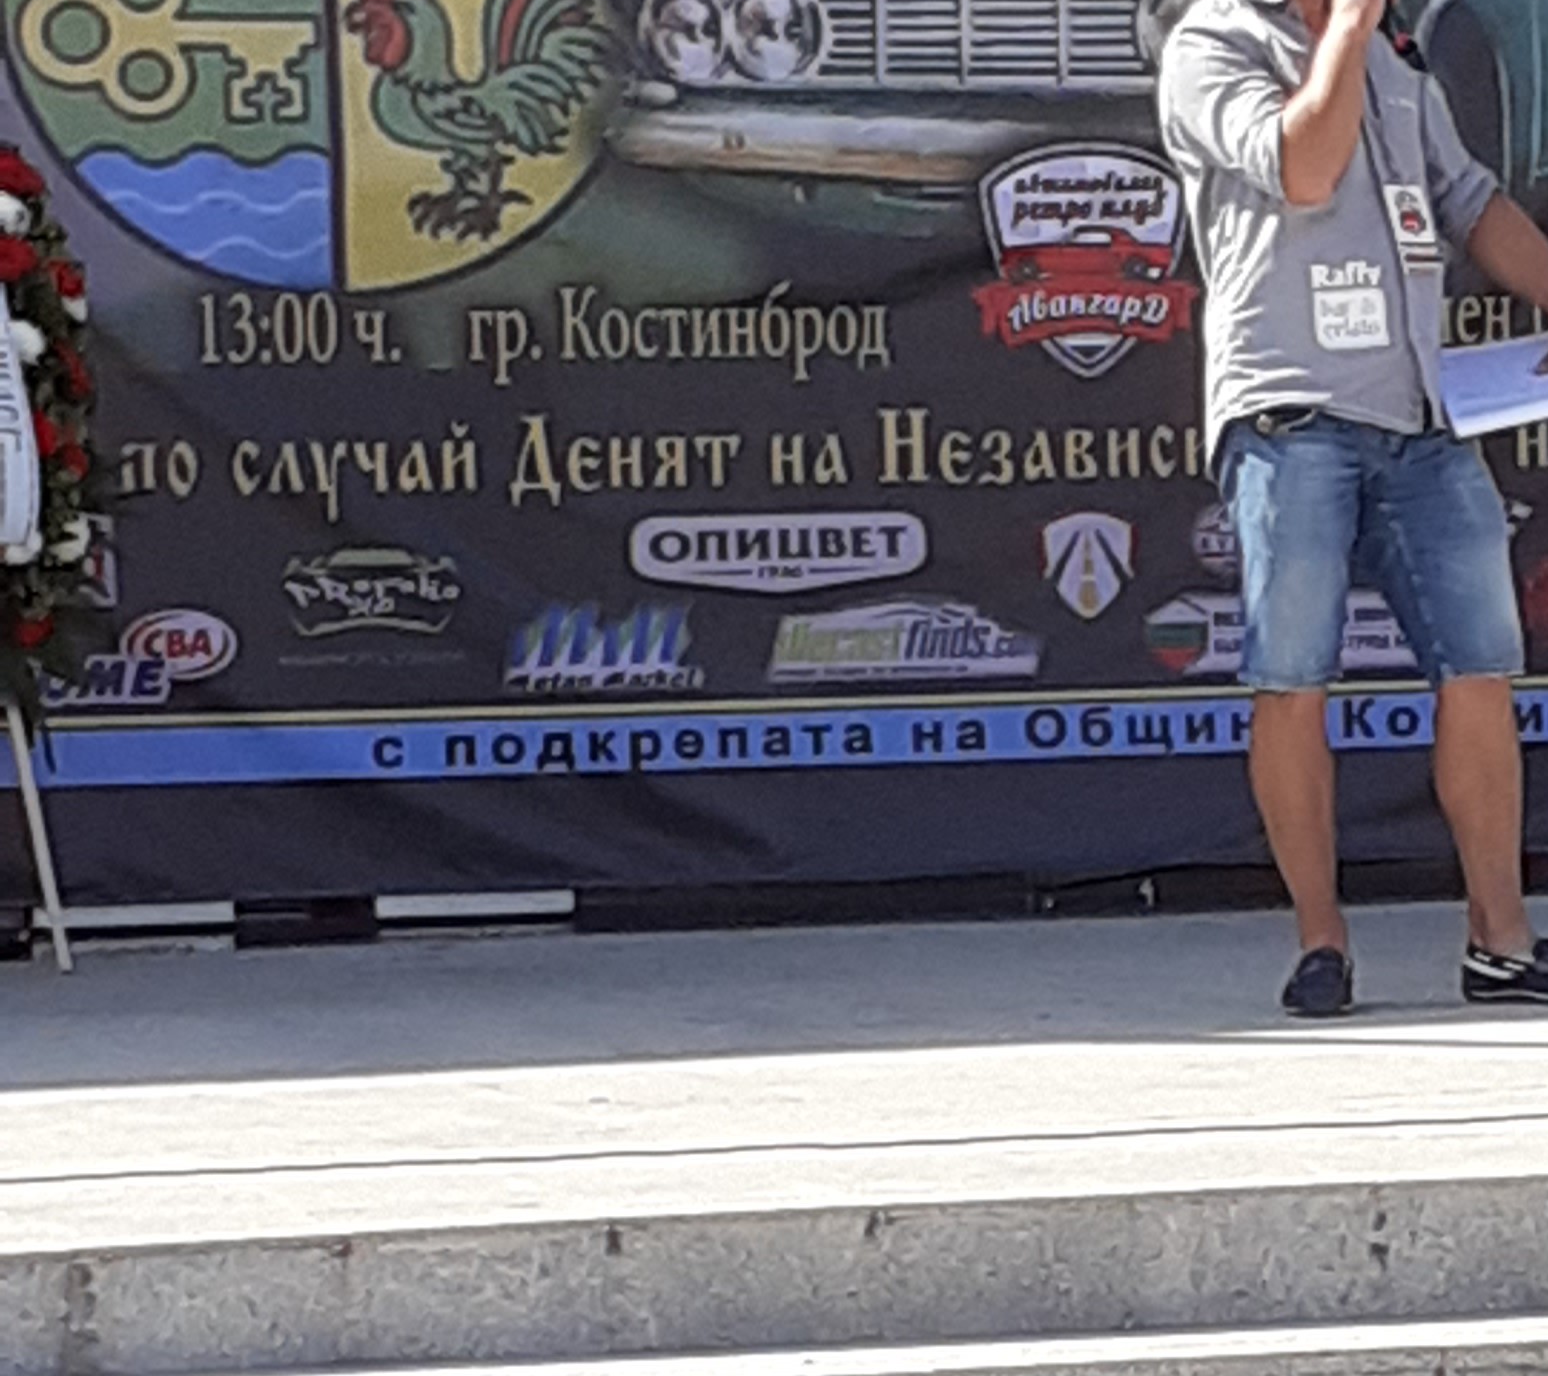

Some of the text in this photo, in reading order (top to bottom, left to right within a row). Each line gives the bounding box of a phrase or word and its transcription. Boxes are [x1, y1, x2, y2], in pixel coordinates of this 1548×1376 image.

[199, 291, 338, 365] 13:00
[353, 308, 403, 365] ч.
[468, 308, 543, 384] гр.
[559, 281, 891, 381] Костинброд
[118, 441, 198, 497] по
[231, 420, 478, 522] случай
[510, 414, 741, 506] Денят
[770, 432, 850, 486] на
[877, 406, 1206, 485] Независ
[648, 524, 908, 564] ОПИЦВЕТ
[443, 721, 874, 774] подкрепата
[911, 719, 988, 754] на
[1023, 706, 1253, 755] Общин
